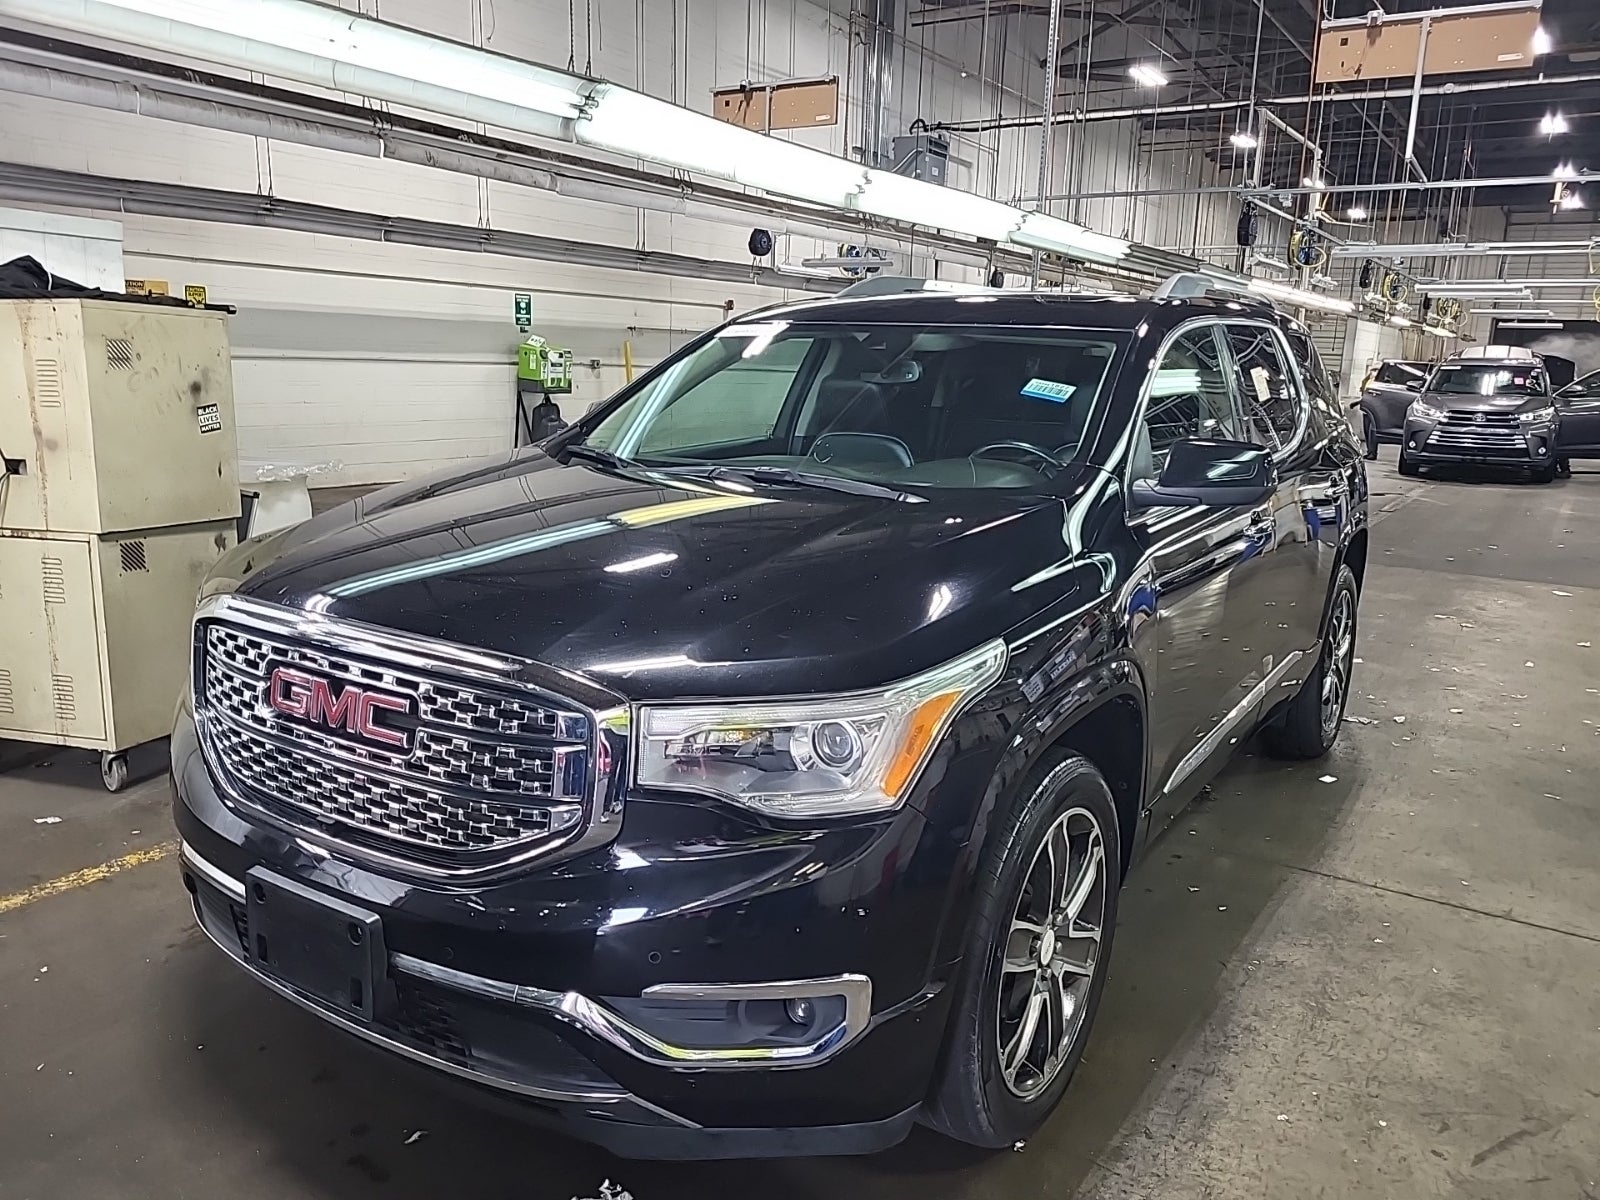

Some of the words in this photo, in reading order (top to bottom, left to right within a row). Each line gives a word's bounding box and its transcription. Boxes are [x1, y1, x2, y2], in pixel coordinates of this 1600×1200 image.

[197, 406, 217, 416] BLACK
[200, 414, 219, 424] LIVES
[201, 423, 220, 432] MATTER
[271, 667, 409, 748] GMC
